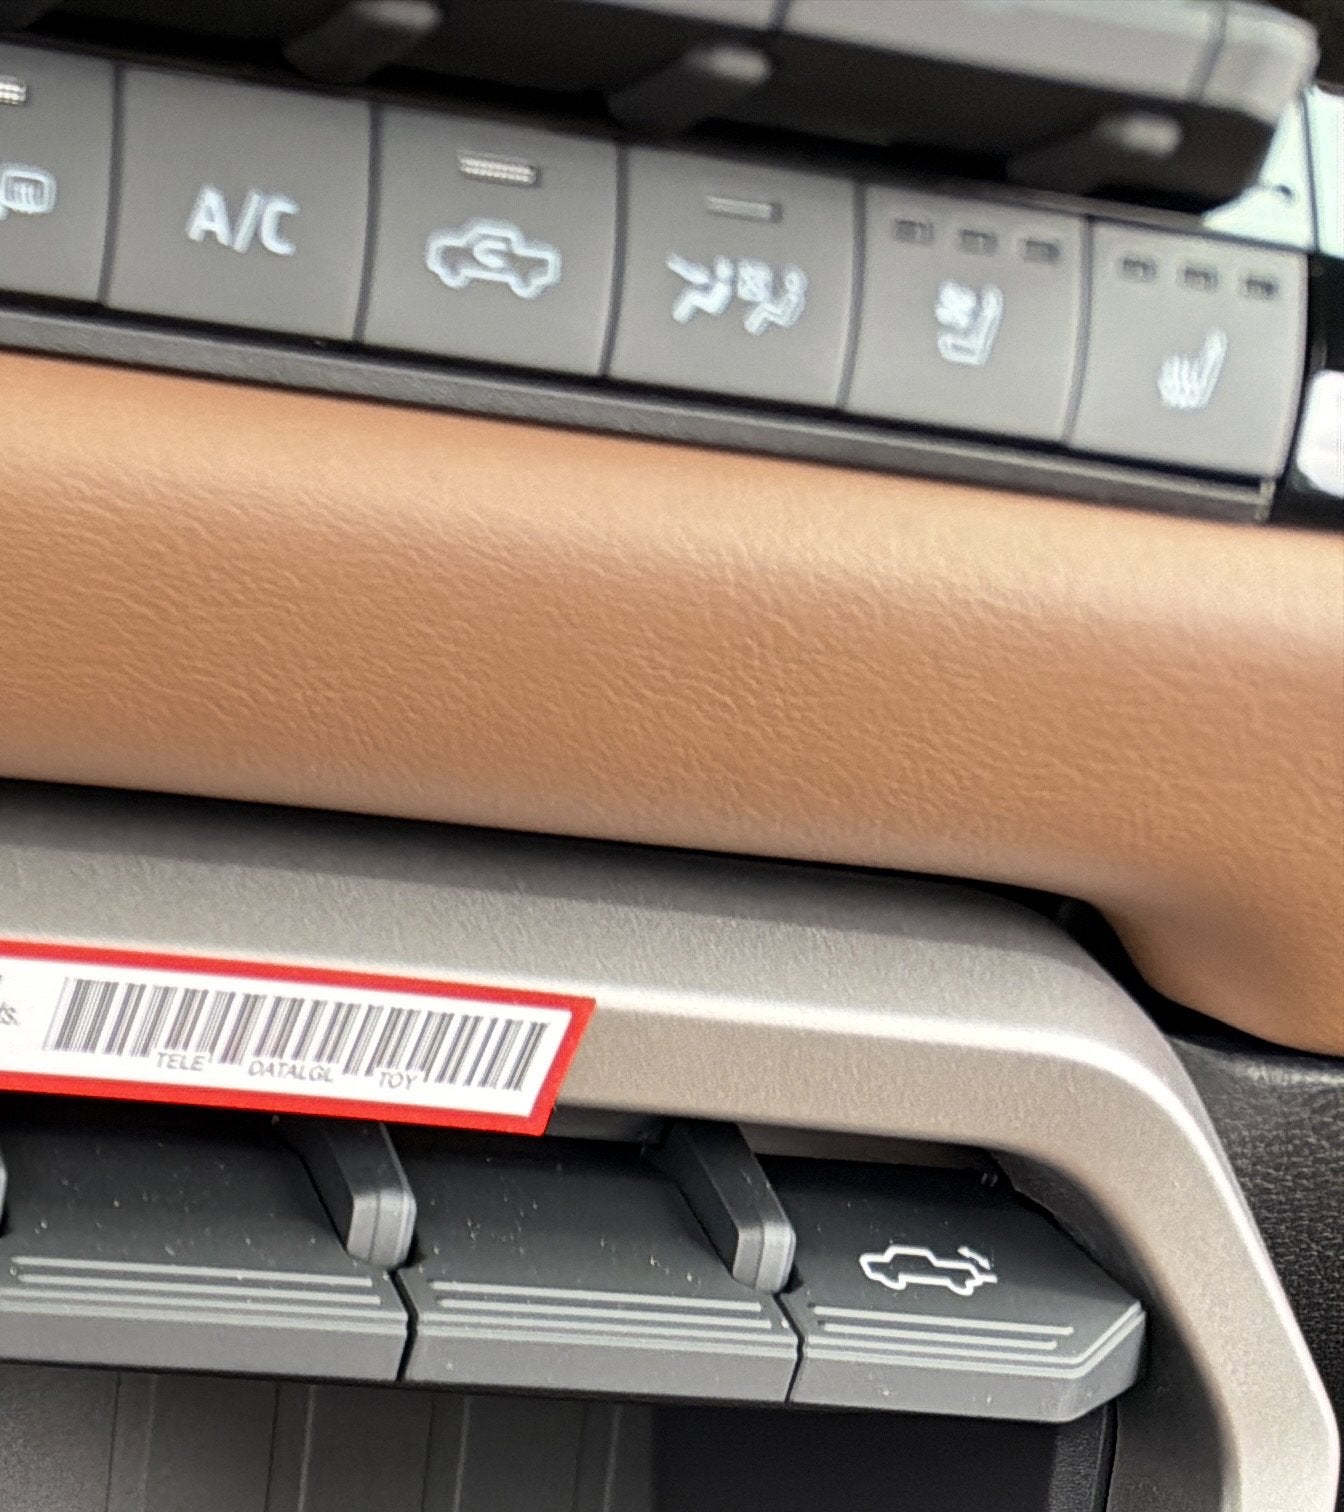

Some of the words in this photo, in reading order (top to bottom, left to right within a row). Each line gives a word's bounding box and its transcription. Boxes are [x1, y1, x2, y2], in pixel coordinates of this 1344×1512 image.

[184, 185, 302, 256] A/C
[155, 1052, 205, 1073] TELE
[378, 1071, 419, 1090] TOY
